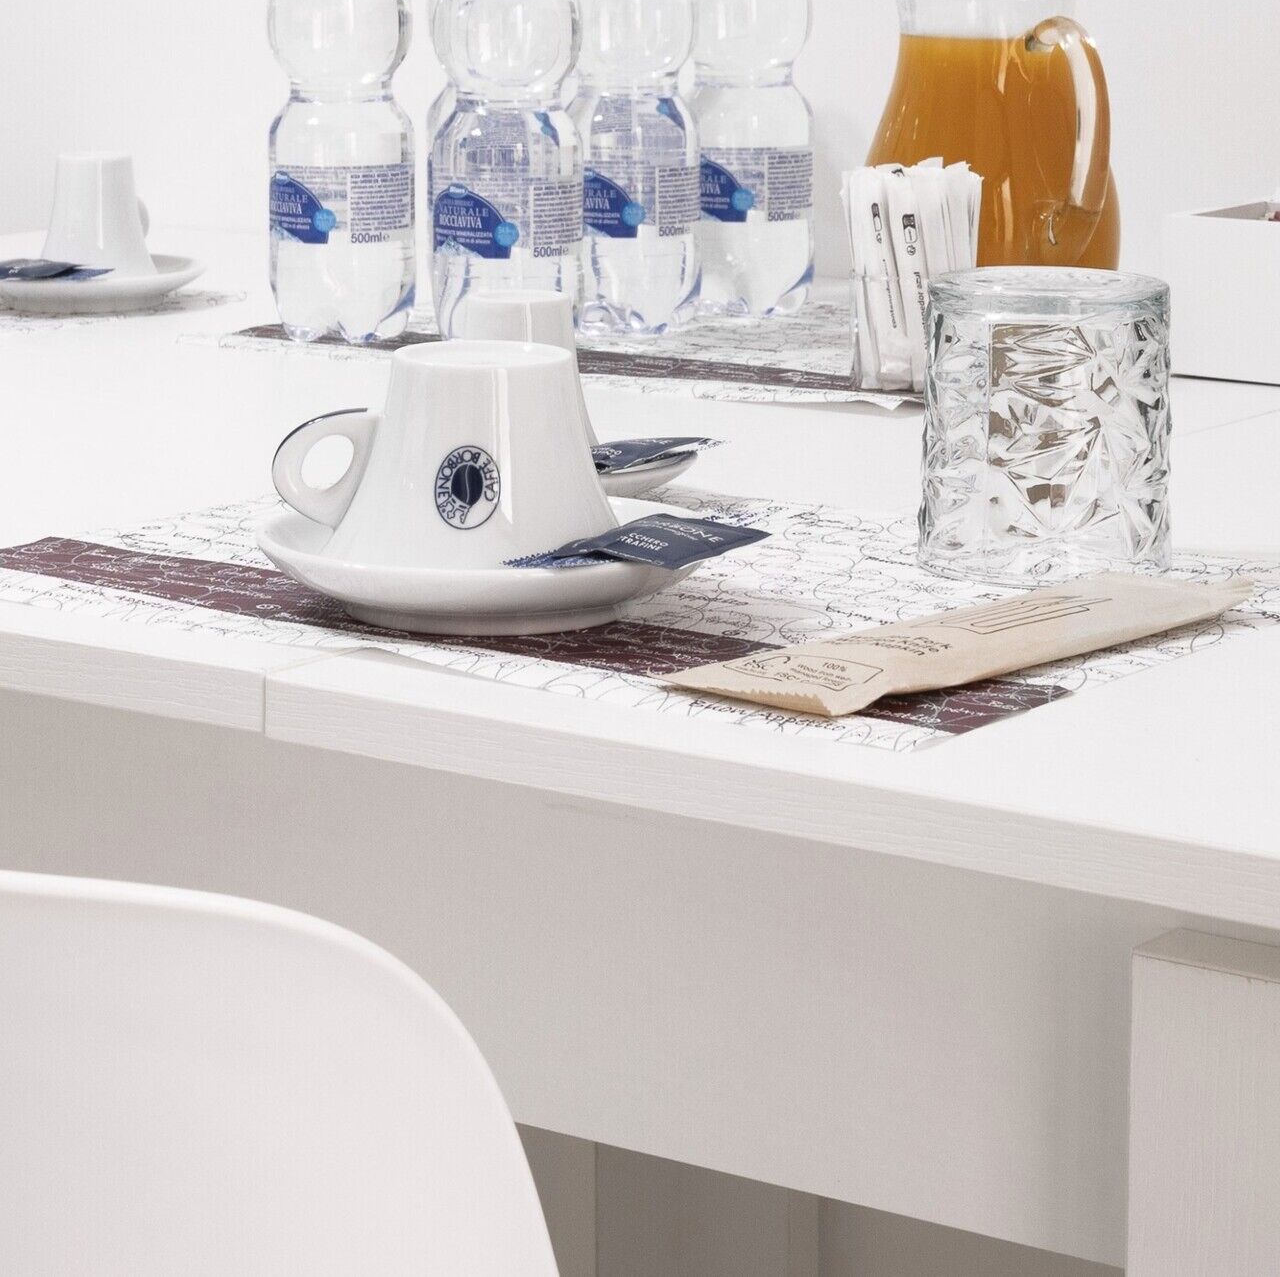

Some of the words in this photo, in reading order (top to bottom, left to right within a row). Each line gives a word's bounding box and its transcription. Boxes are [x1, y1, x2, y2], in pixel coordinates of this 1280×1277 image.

[351, 232, 382, 244] 500ml
[533, 246, 563, 258] 500ml
[438, 449, 481, 499] BORBONE
[619, 535, 663, 552] TRAFINE
[628, 532, 669, 548] CCHERO
